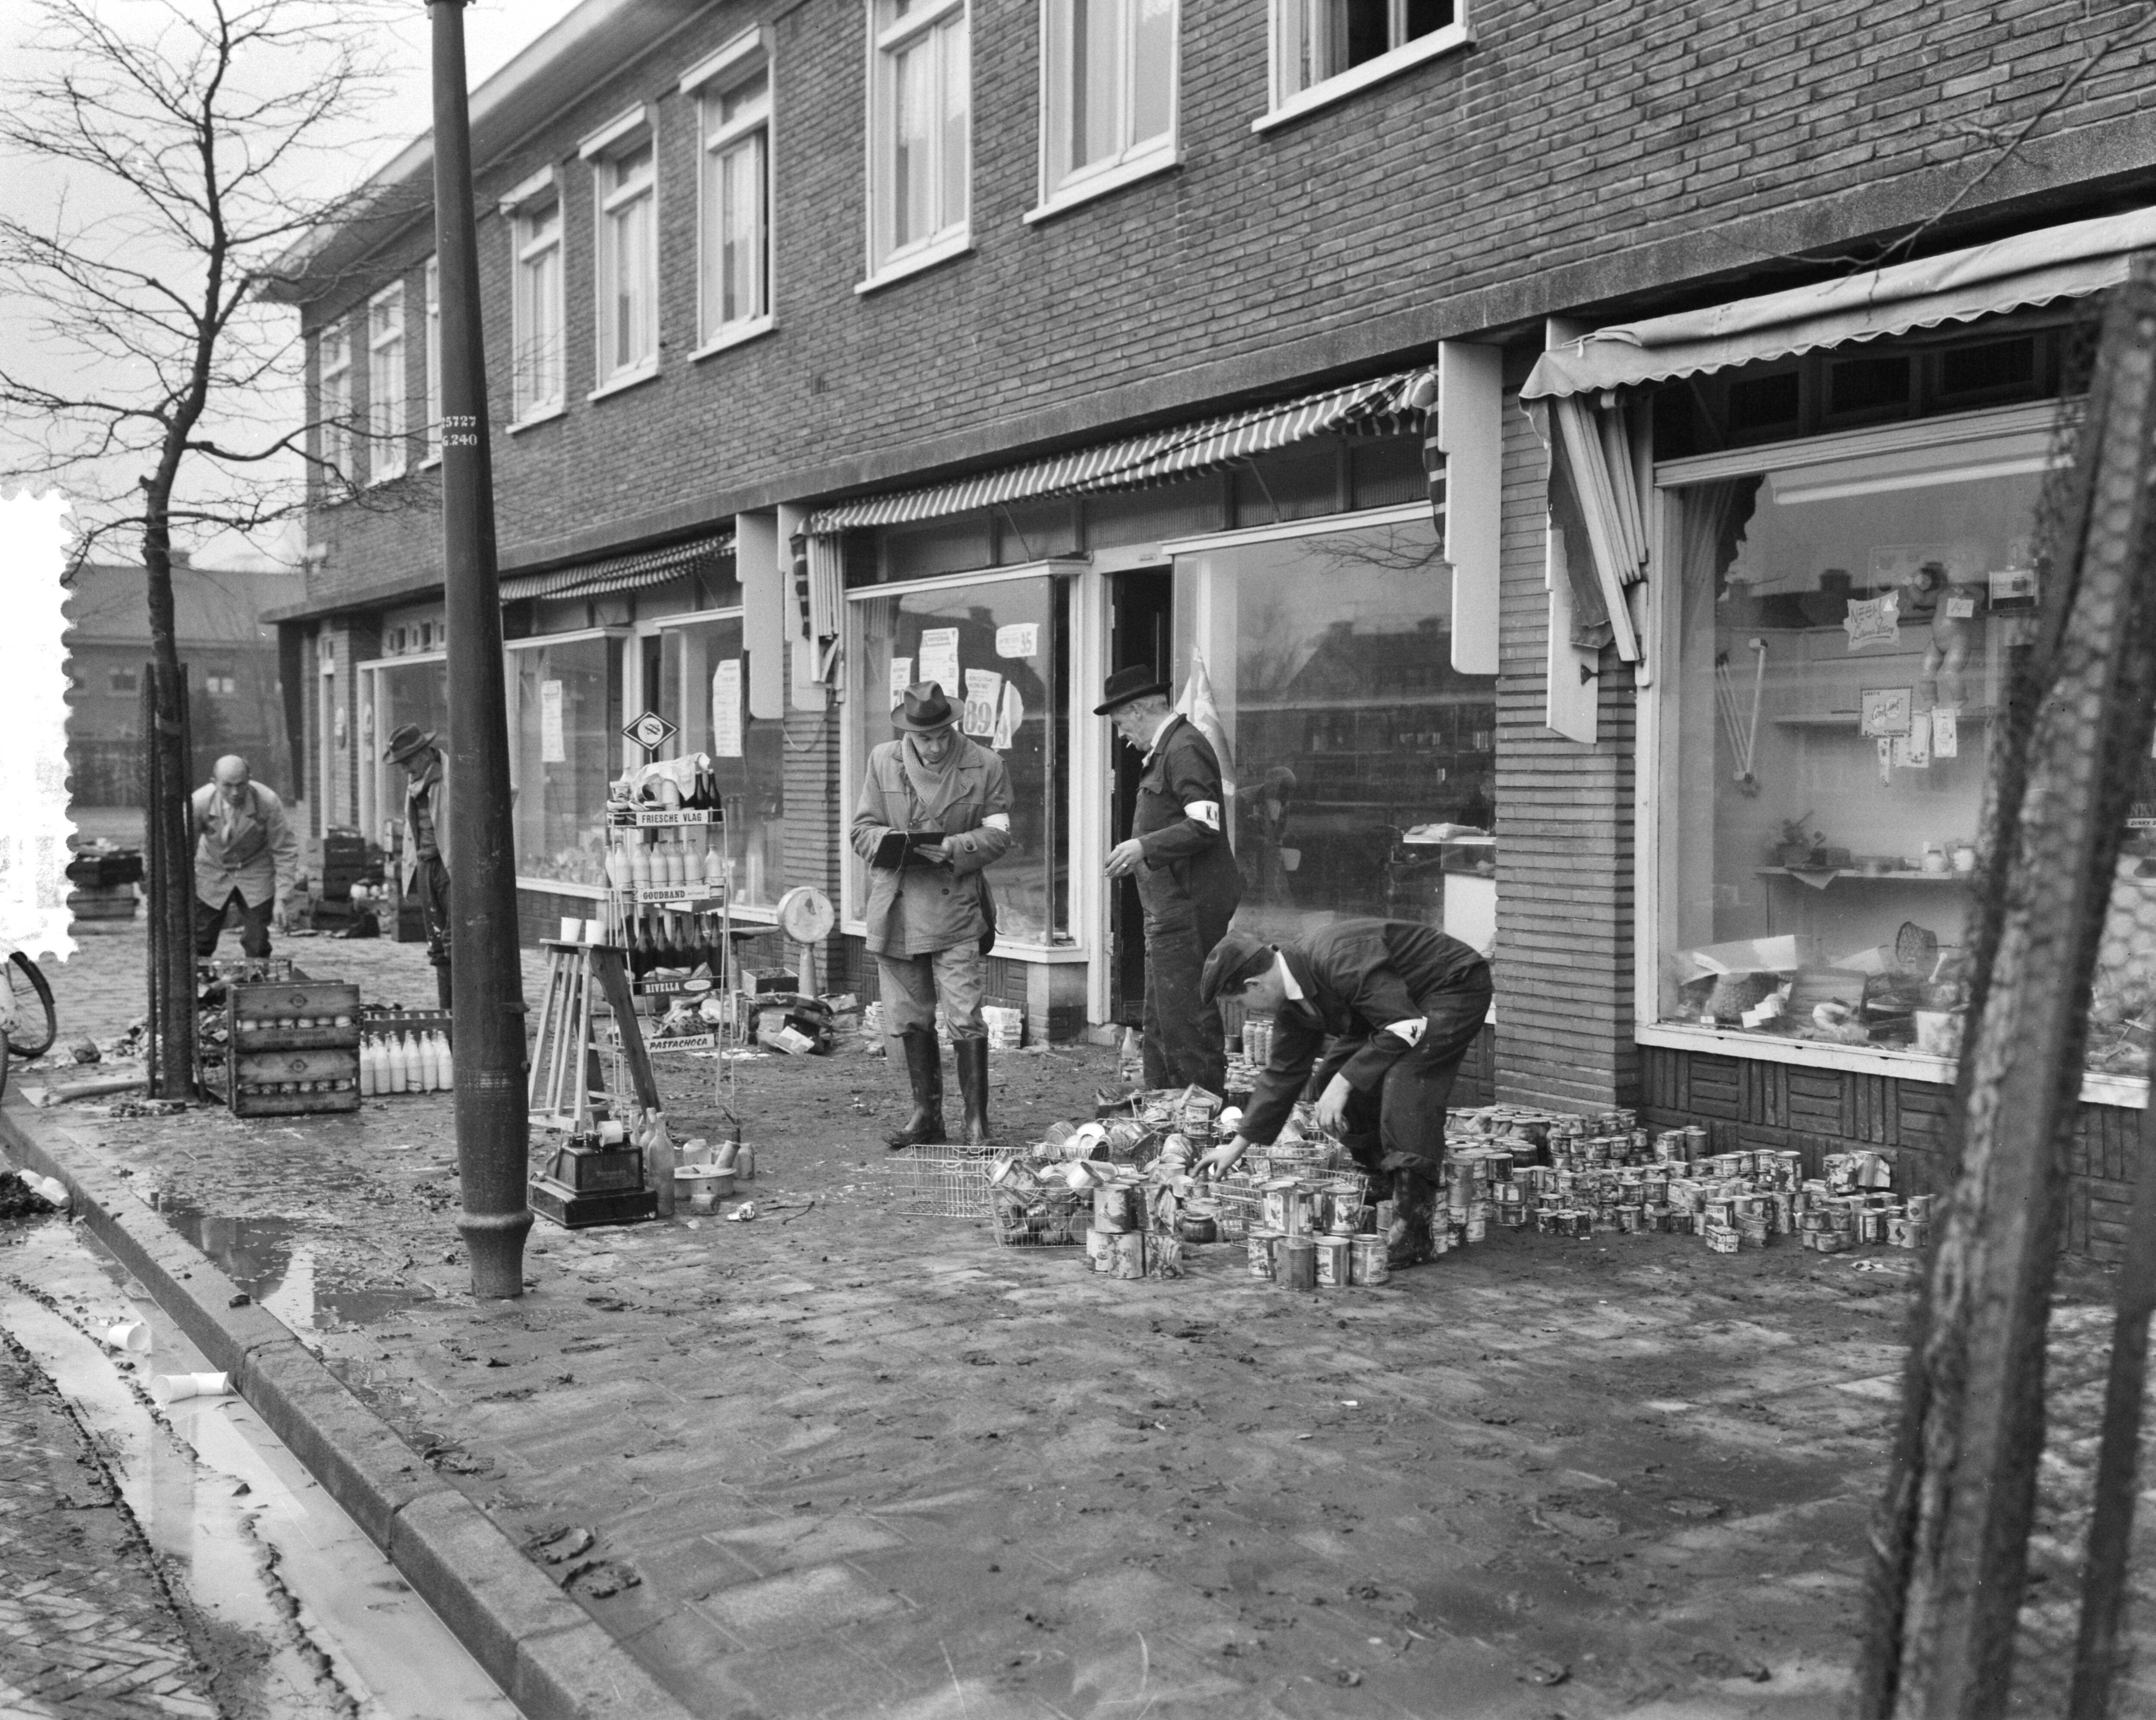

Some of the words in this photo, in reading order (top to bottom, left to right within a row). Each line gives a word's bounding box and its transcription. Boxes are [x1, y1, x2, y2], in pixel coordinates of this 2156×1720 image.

[442, 434, 477, 447] G.240
[965, 700, 992, 734] 89
[642, 812, 679, 823] FRIESCHE
[683, 812, 702, 822] VLAG
[643, 890, 686, 900] GOUDBAND
[645, 982, 680, 994] RIVELLA
[649, 1038, 708, 1050] PASTACHOCA
